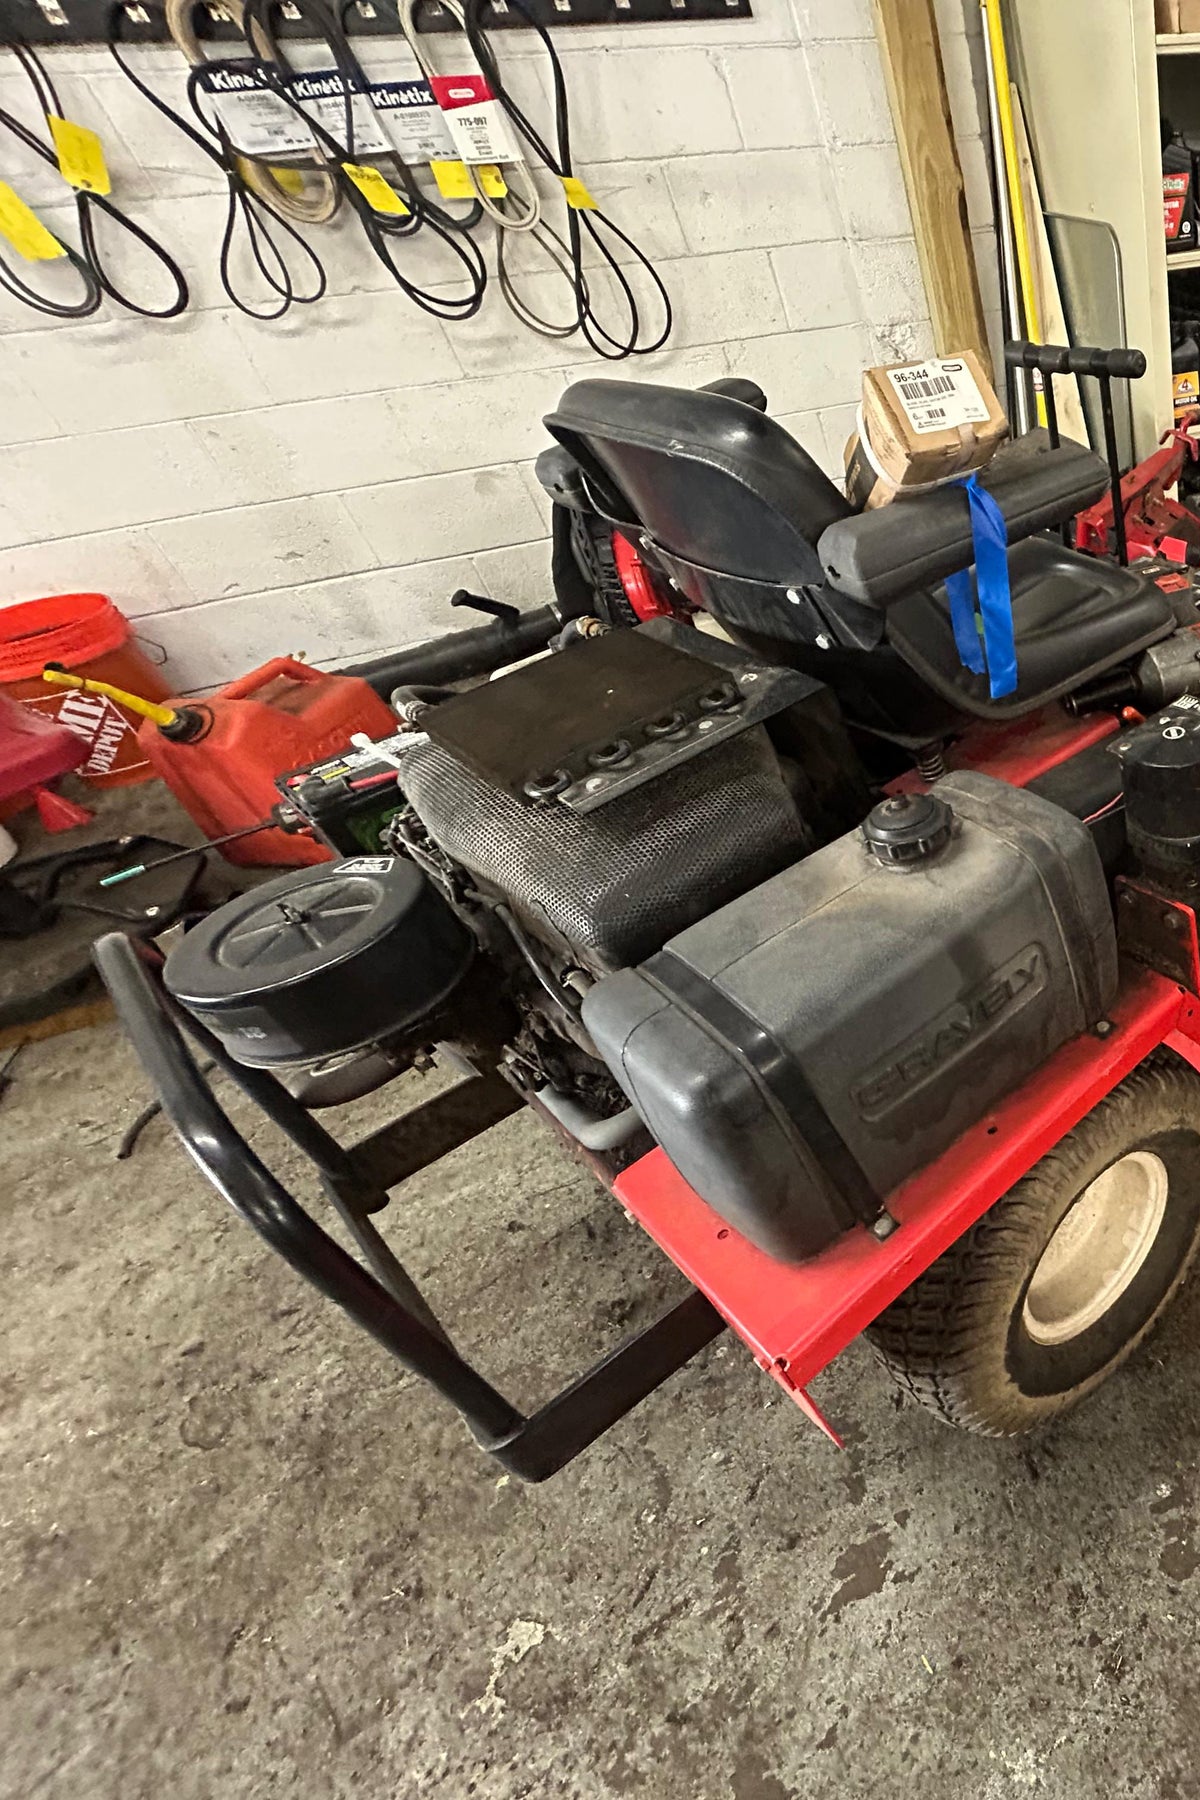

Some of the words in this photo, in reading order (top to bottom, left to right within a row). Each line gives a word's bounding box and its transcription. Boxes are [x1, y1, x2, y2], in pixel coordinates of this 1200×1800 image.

[370, 86, 434, 106] Kinetix
[457, 117, 488, 127] 775-097
[893, 369, 930, 383] 96-344
[86, 716, 129, 773] DEPOT
